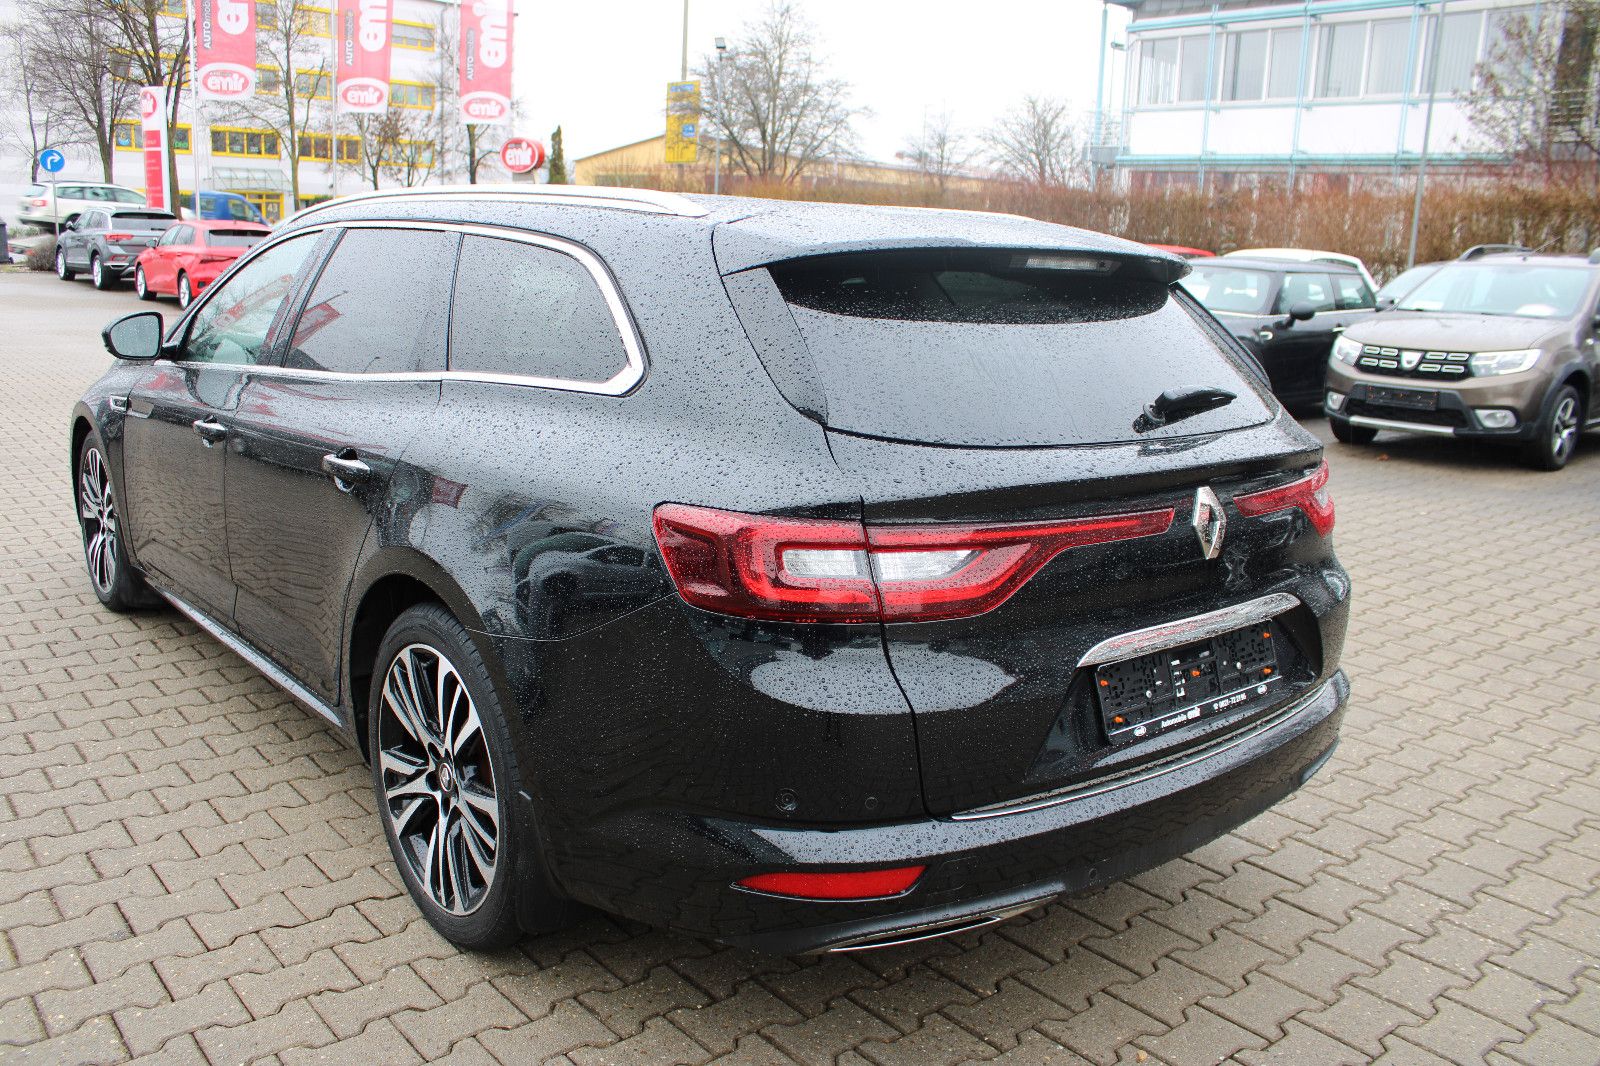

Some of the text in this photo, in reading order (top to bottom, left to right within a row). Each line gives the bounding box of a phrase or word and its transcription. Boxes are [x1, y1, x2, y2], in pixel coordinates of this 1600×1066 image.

[207, 73, 245, 91] emir
[347, 87, 380, 104] emir
[468, 100, 502, 116] emir
[505, 141, 532, 165] emir
